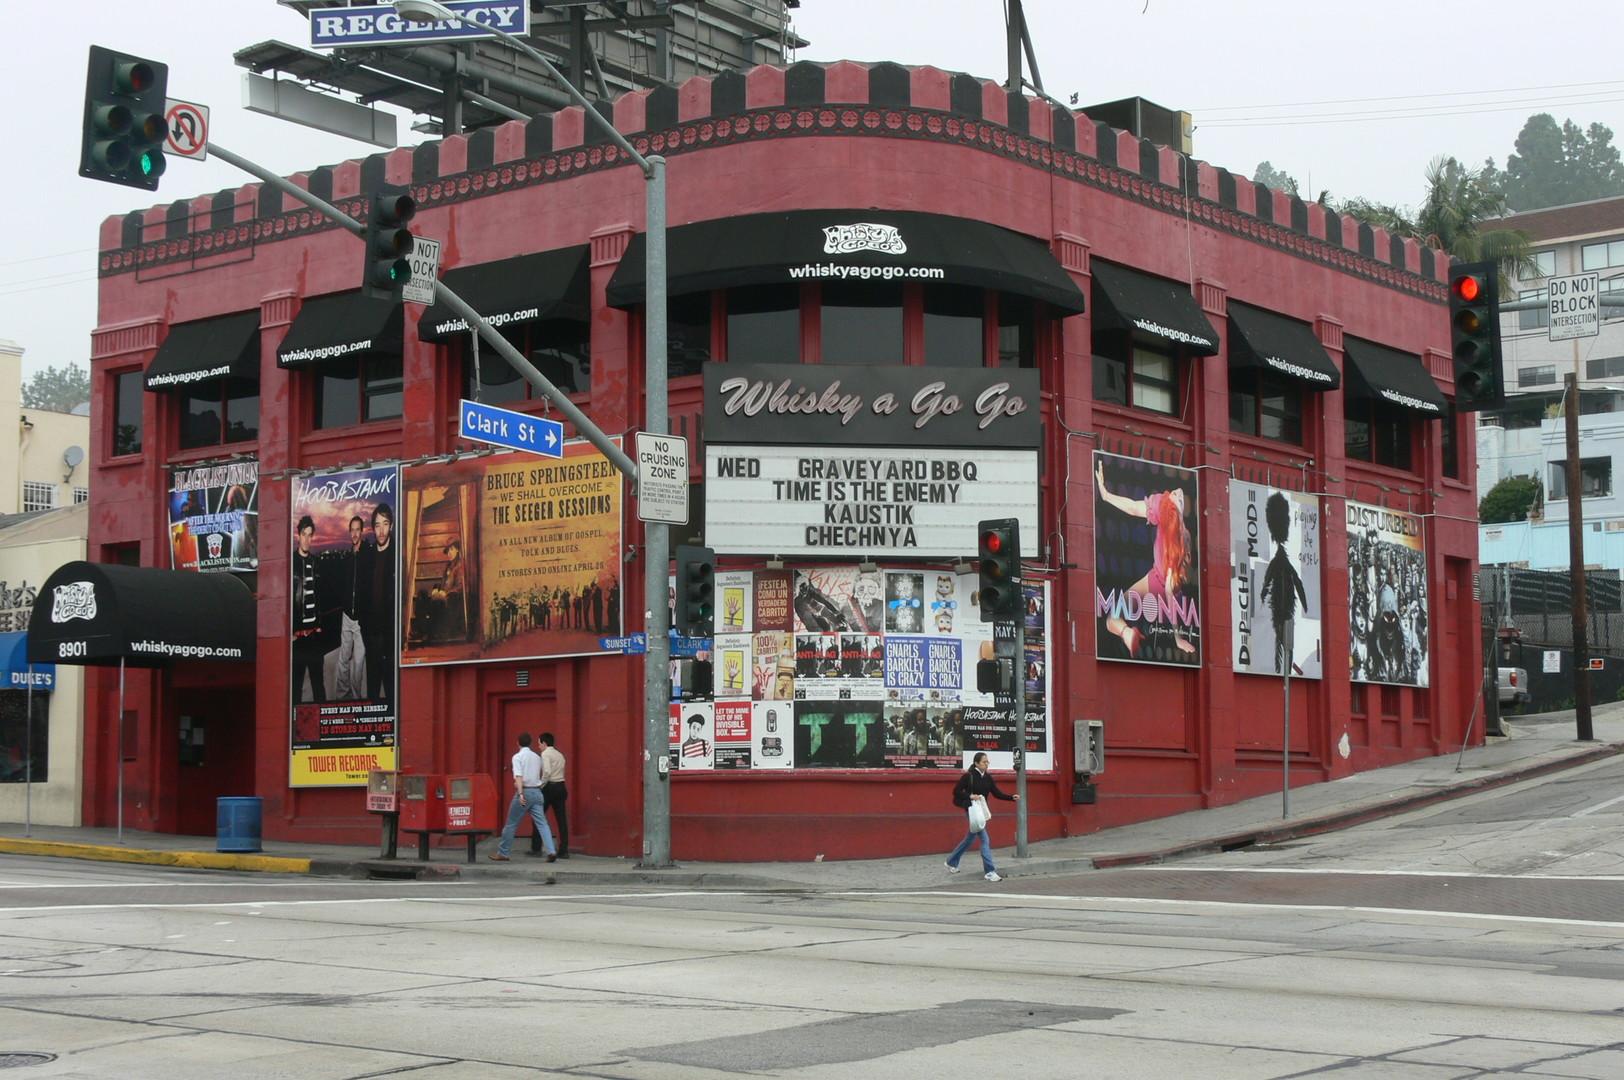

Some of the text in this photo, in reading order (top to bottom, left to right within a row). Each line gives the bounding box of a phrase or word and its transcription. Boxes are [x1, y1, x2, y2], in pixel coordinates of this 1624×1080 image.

[418, 242, 438, 260] NOT
[412, 259, 435, 278] OCK
[789, 263, 944, 279] whiskyagogo.com
[410, 278, 434, 291] SECTION
[1551, 276, 1596, 296] DO NOT
[1551, 295, 1596, 314] BLOCK
[435, 307, 539, 335] whiskogo.com
[1551, 312, 1597, 328] INTERSECTION
[1133, 319, 1212, 346] whiskyagogo.com
[280, 338, 371, 363] whiskyagogo.com
[147, 364, 230, 386] whiskyagogo.com
[1265, 356, 1332, 382] whiskyagogo.com
[720, 377, 1027, 430] Whisky a Go Go
[1380, 388, 1439, 411] whiskyagogo.com
[467, 410, 535, 443] Clark St
[655, 441, 669, 453] NO
[640, 452, 685, 468] CRUISING
[717, 457, 978, 481] WED GRAVEYARD BBQ
[174, 462, 259, 492] BLACKLIST UNION
[487, 460, 617, 491] BRUCE SPRINGSTEEN
[650, 466, 677, 479] ZONE
[295, 473, 396, 507] HOOBASTANK
[500, 482, 603, 502] WE SHALL OVERCOME
[773, 480, 960, 503] TIME IS THE ENEMY
[493, 494, 611, 525] THE SEEGER SESSIONS
[824, 503, 914, 525] KAUSTIK
[1346, 504, 1418, 537] DISTURBED
[539, 533, 563, 543] ALBUM
[805, 526, 918, 547] CHECHNYA
[541, 546, 555, 555] AND
[533, 566, 547, 575] AND
[547, 564, 572, 574] ONLINE
[573, 562, 594, 572] APRIL
[757, 589, 788, 599] COMO UN
[1096, 586, 1200, 627] MADONNA
[59, 641, 87, 657] 8901
[131, 640, 242, 657] whiskyagogo.com
[606, 638, 631, 648] SUNSET
[677, 639, 702, 648] CLARK
[757, 635, 777, 647] 100%
[886, 643, 919, 658] GNARLS
[928, 644, 956, 660] GNARLS
[886, 657, 924, 672] BARKLEY
[928, 659, 961, 674] BARKLEY
[11, 672, 52, 685] DUKE'S
[887, 672, 896, 686] IS
[898, 671, 925, 687] CRAZY
[929, 672, 961, 688] IS CRAZY
[716, 720, 745, 729] INVISIBLE
[307, 754, 377, 773] TOWER RECORDS
